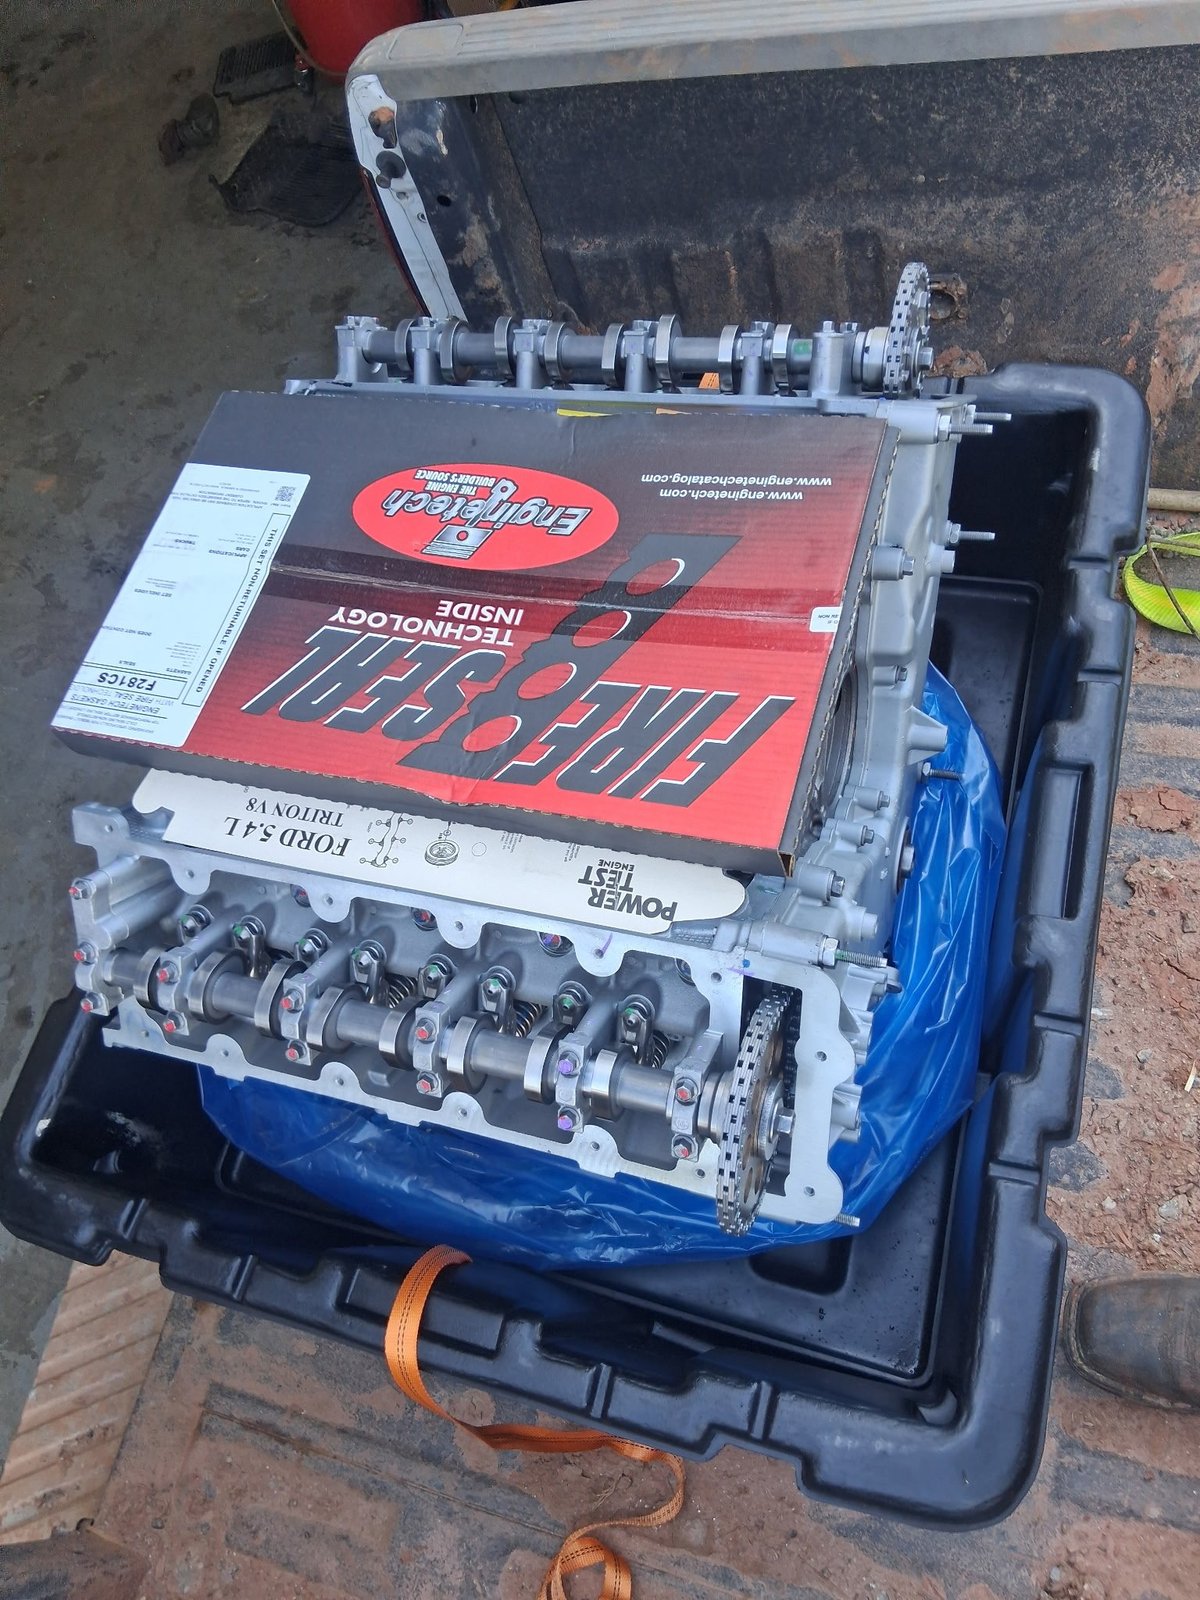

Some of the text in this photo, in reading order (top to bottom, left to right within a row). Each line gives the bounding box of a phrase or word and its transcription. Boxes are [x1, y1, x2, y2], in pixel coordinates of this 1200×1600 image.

[414, 468, 496, 486] BUILDER'S SOURCE
[424, 480, 477, 496] THE ENGINE
[641, 473, 832, 488] www.enginetechcatalog.com
[659, 488, 803, 500] www.enginetech.com
[382, 489, 592, 536] Enginetech
[196, 528, 278, 693] THIS SET NON-RETURNABLE IF OPENED
[436, 600, 525, 626] INSIDE
[328, 606, 515, 646] TECHNOLOGY
[97, 672, 156, 692] F281CS
[240, 626, 796, 808] FIRE SEAL
[244, 797, 267, 813] V8
[271, 802, 344, 827] TRITON
[222, 816, 241, 836] L
[244, 821, 277, 844] 5.4
[279, 826, 352, 857] FORD
[598, 858, 634, 872] ENGINE
[578, 865, 634, 892] TEST
[587, 886, 678, 922] POWER
